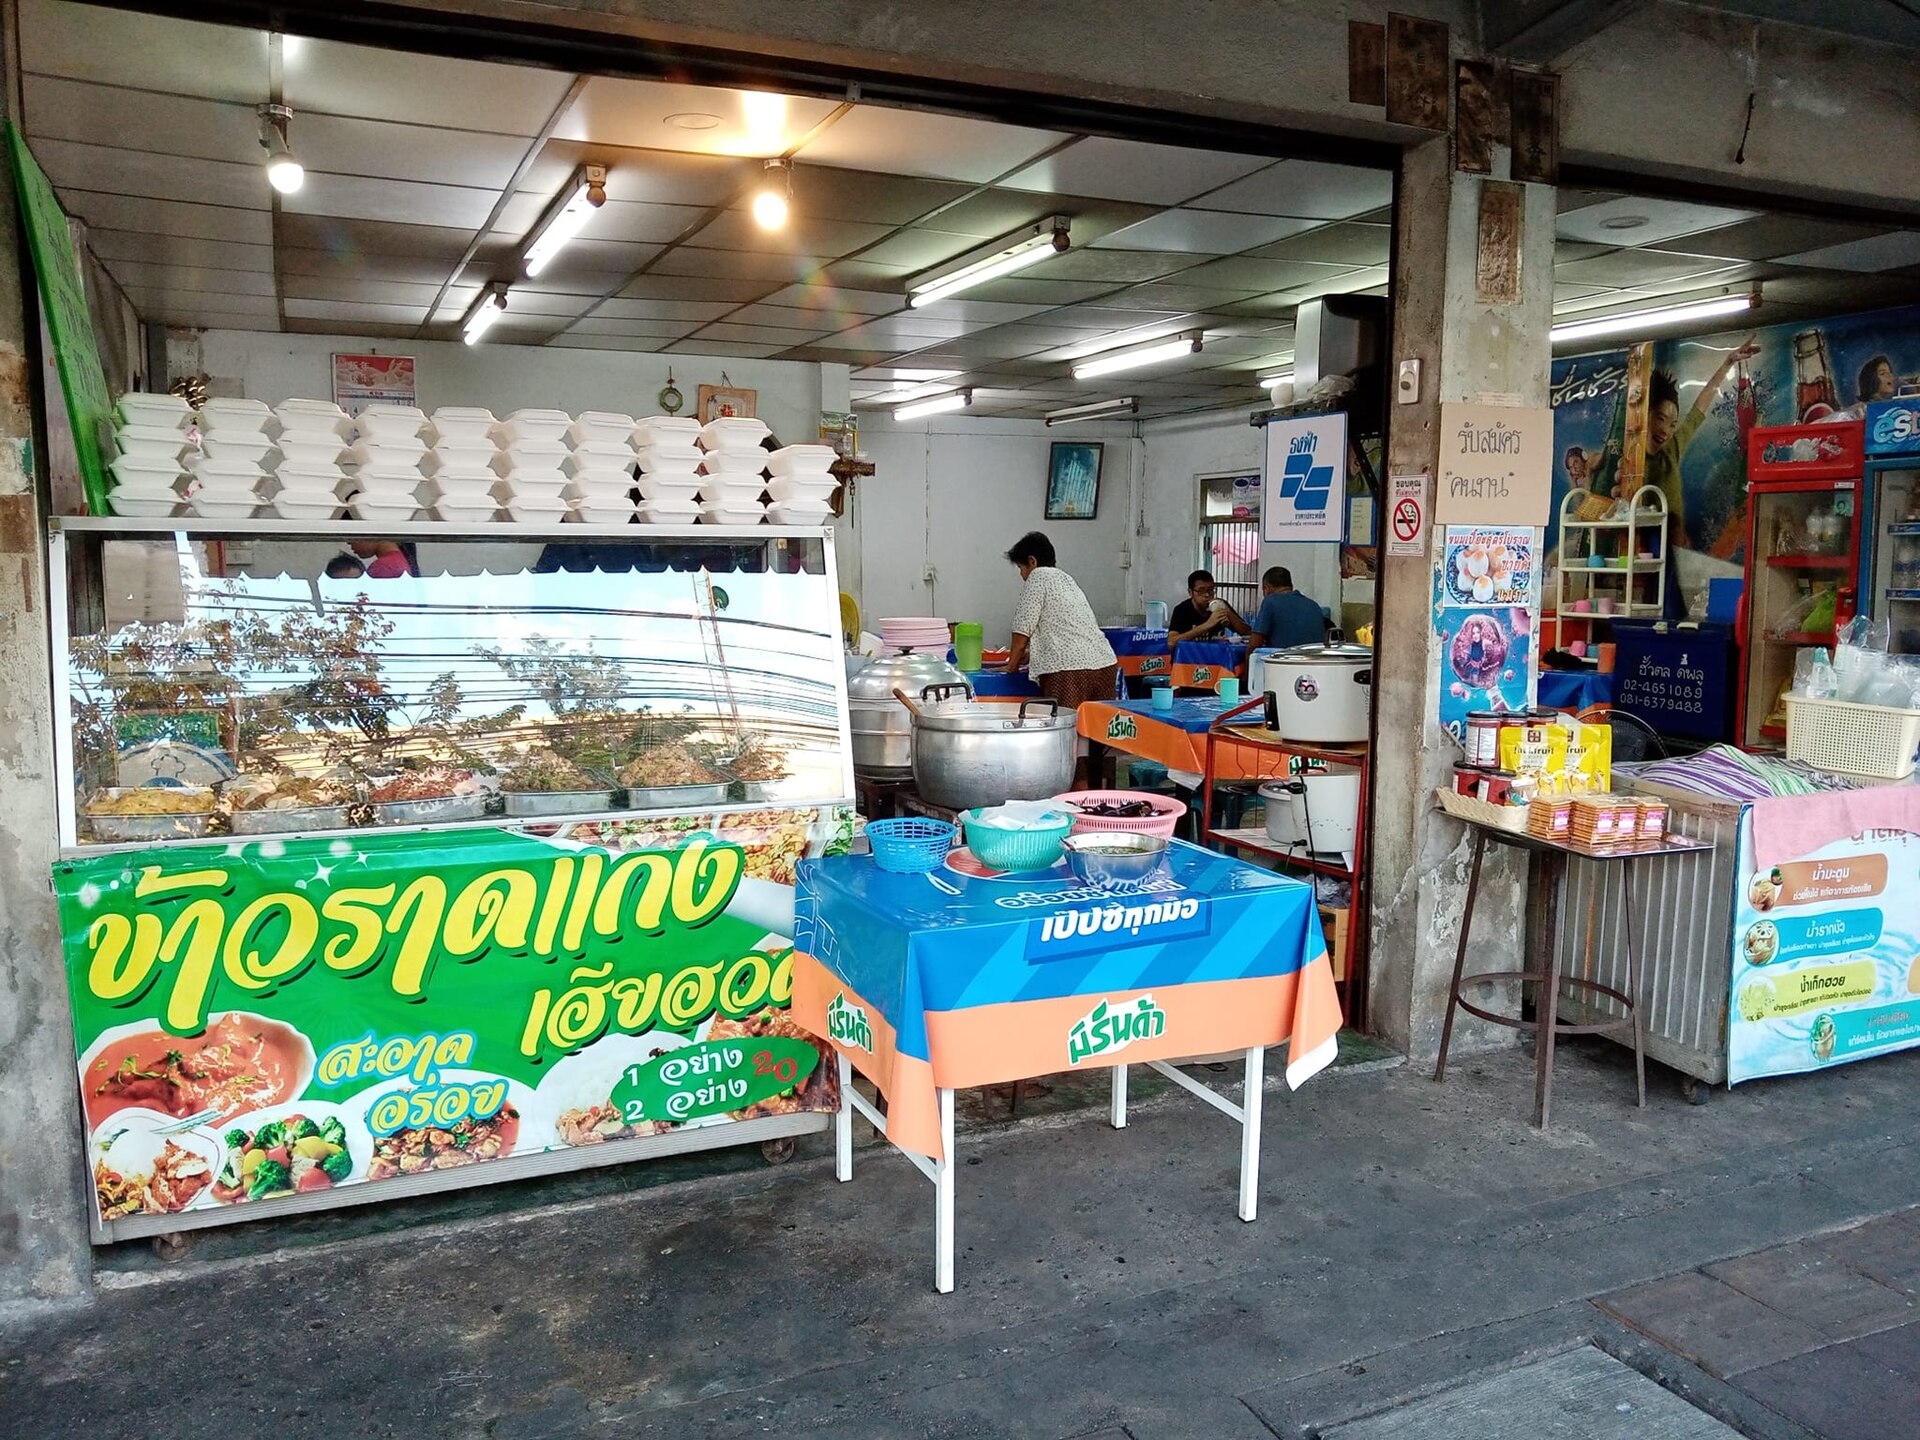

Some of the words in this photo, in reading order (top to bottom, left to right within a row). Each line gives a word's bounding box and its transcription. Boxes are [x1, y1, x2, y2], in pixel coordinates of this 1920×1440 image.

[1290, 431, 1318, 454] ธงฟ้า
[1458, 421, 1522, 454] รับสมัคร
[1812, 863, 1850, 882] น้ำมะตูม
[87, 840, 741, 1030] ข้าวราดแกง
[1806, 919, 1846, 938] น้ำรากบัว
[317, 1033, 474, 1086] สะอาด
[627, 1067, 639, 1087] 1
[660, 1046, 744, 1086] อย่าง
[370, 1073, 506, 1134] อร่อย
[625, 1101, 645, 1121] 2
[666, 1079, 748, 1118] อย่าง
